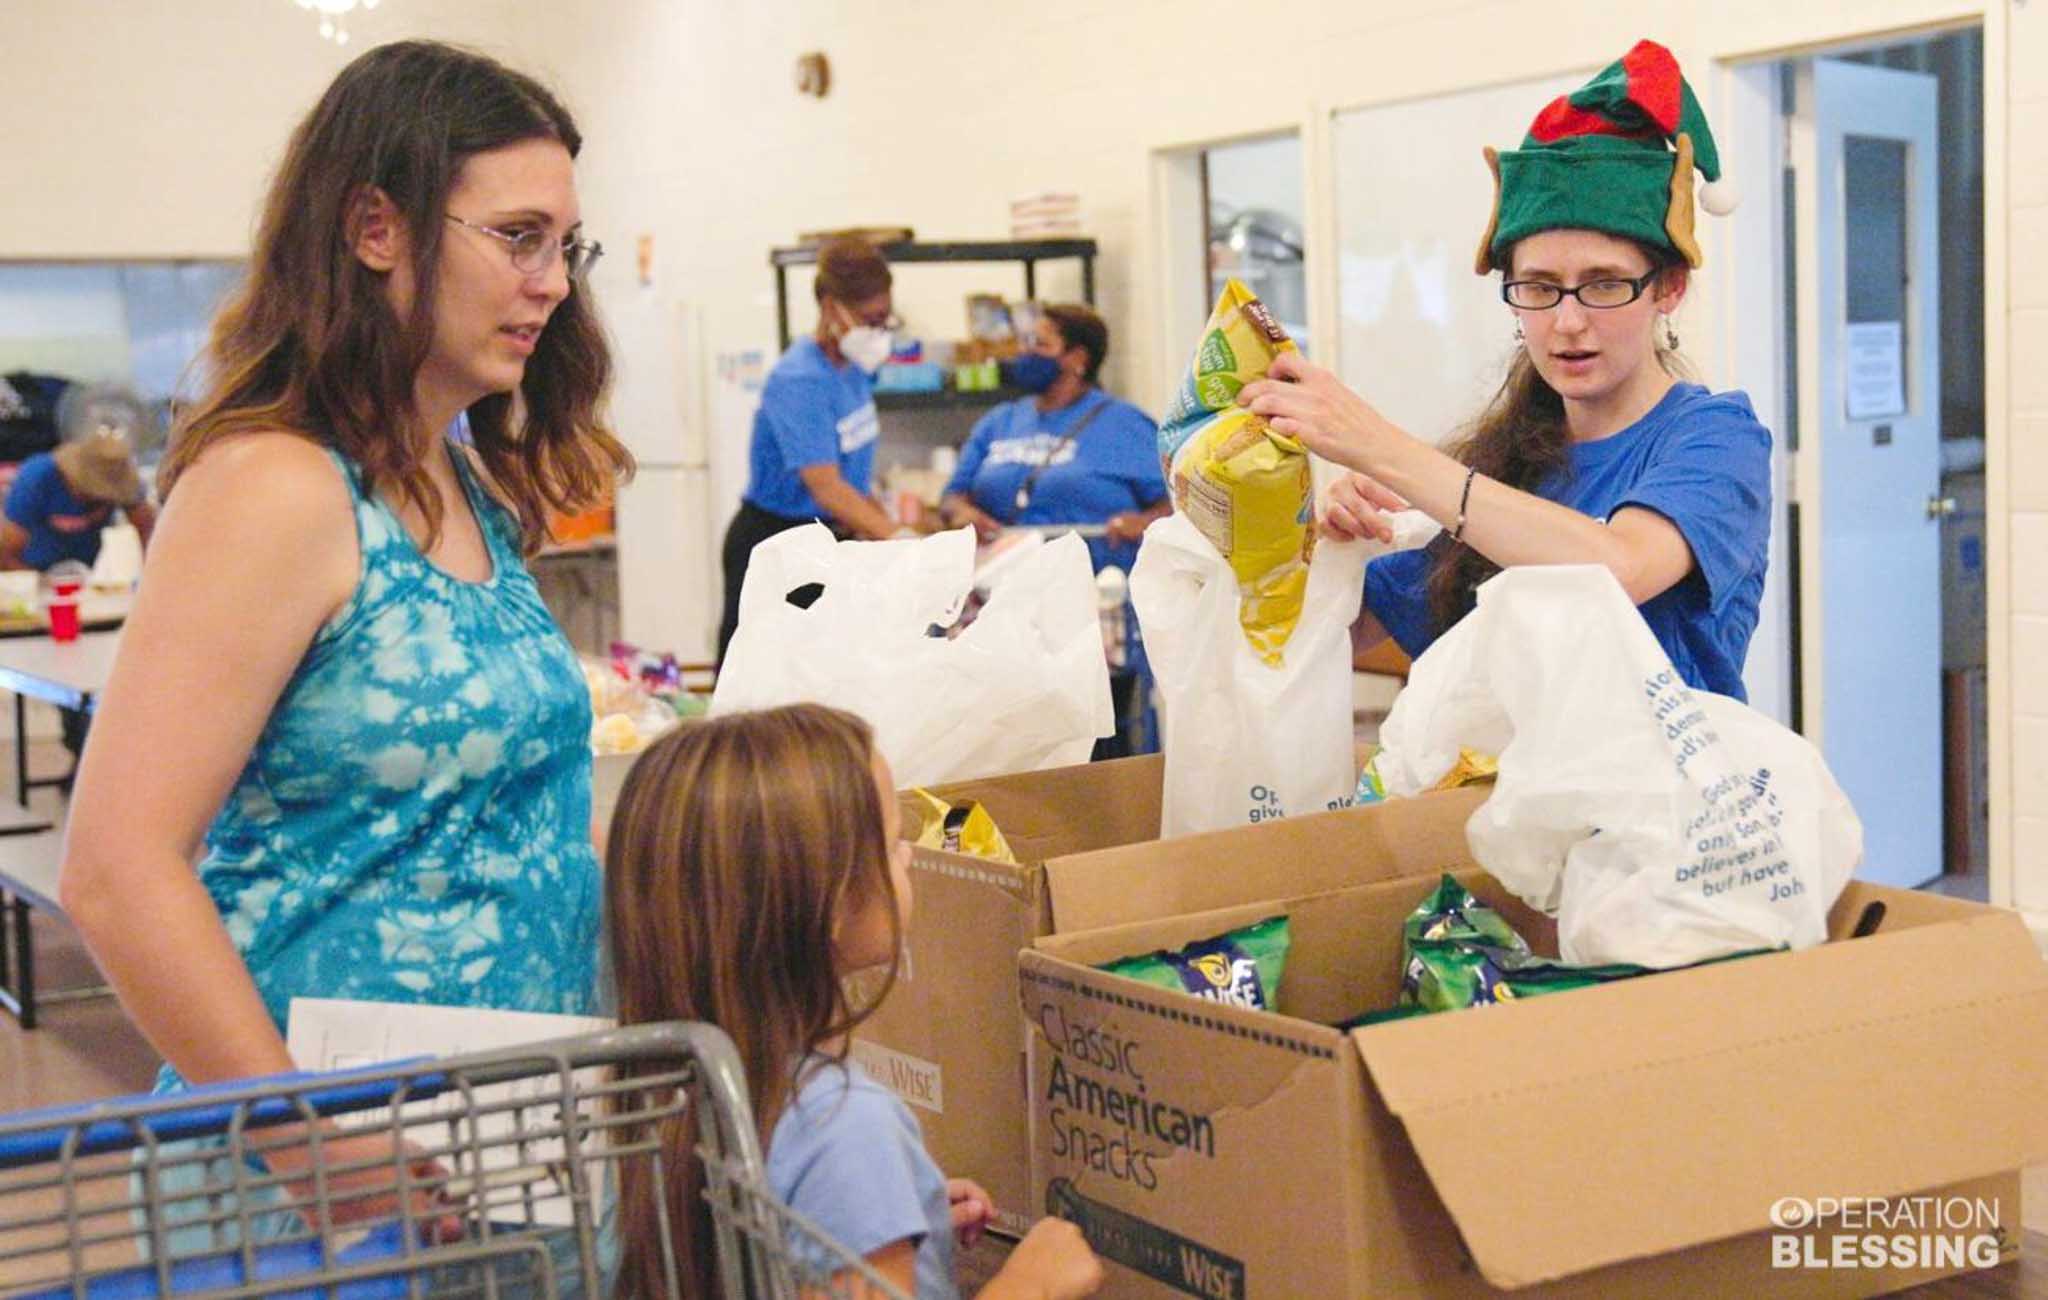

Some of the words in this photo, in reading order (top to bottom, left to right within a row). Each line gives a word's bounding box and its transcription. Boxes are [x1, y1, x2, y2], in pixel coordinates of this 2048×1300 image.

[1740, 859, 1791, 887] have
[1040, 1003, 1143, 1080] Classic
[1046, 1057, 1216, 1159] American
[1051, 1107, 1158, 1192] Snacks
